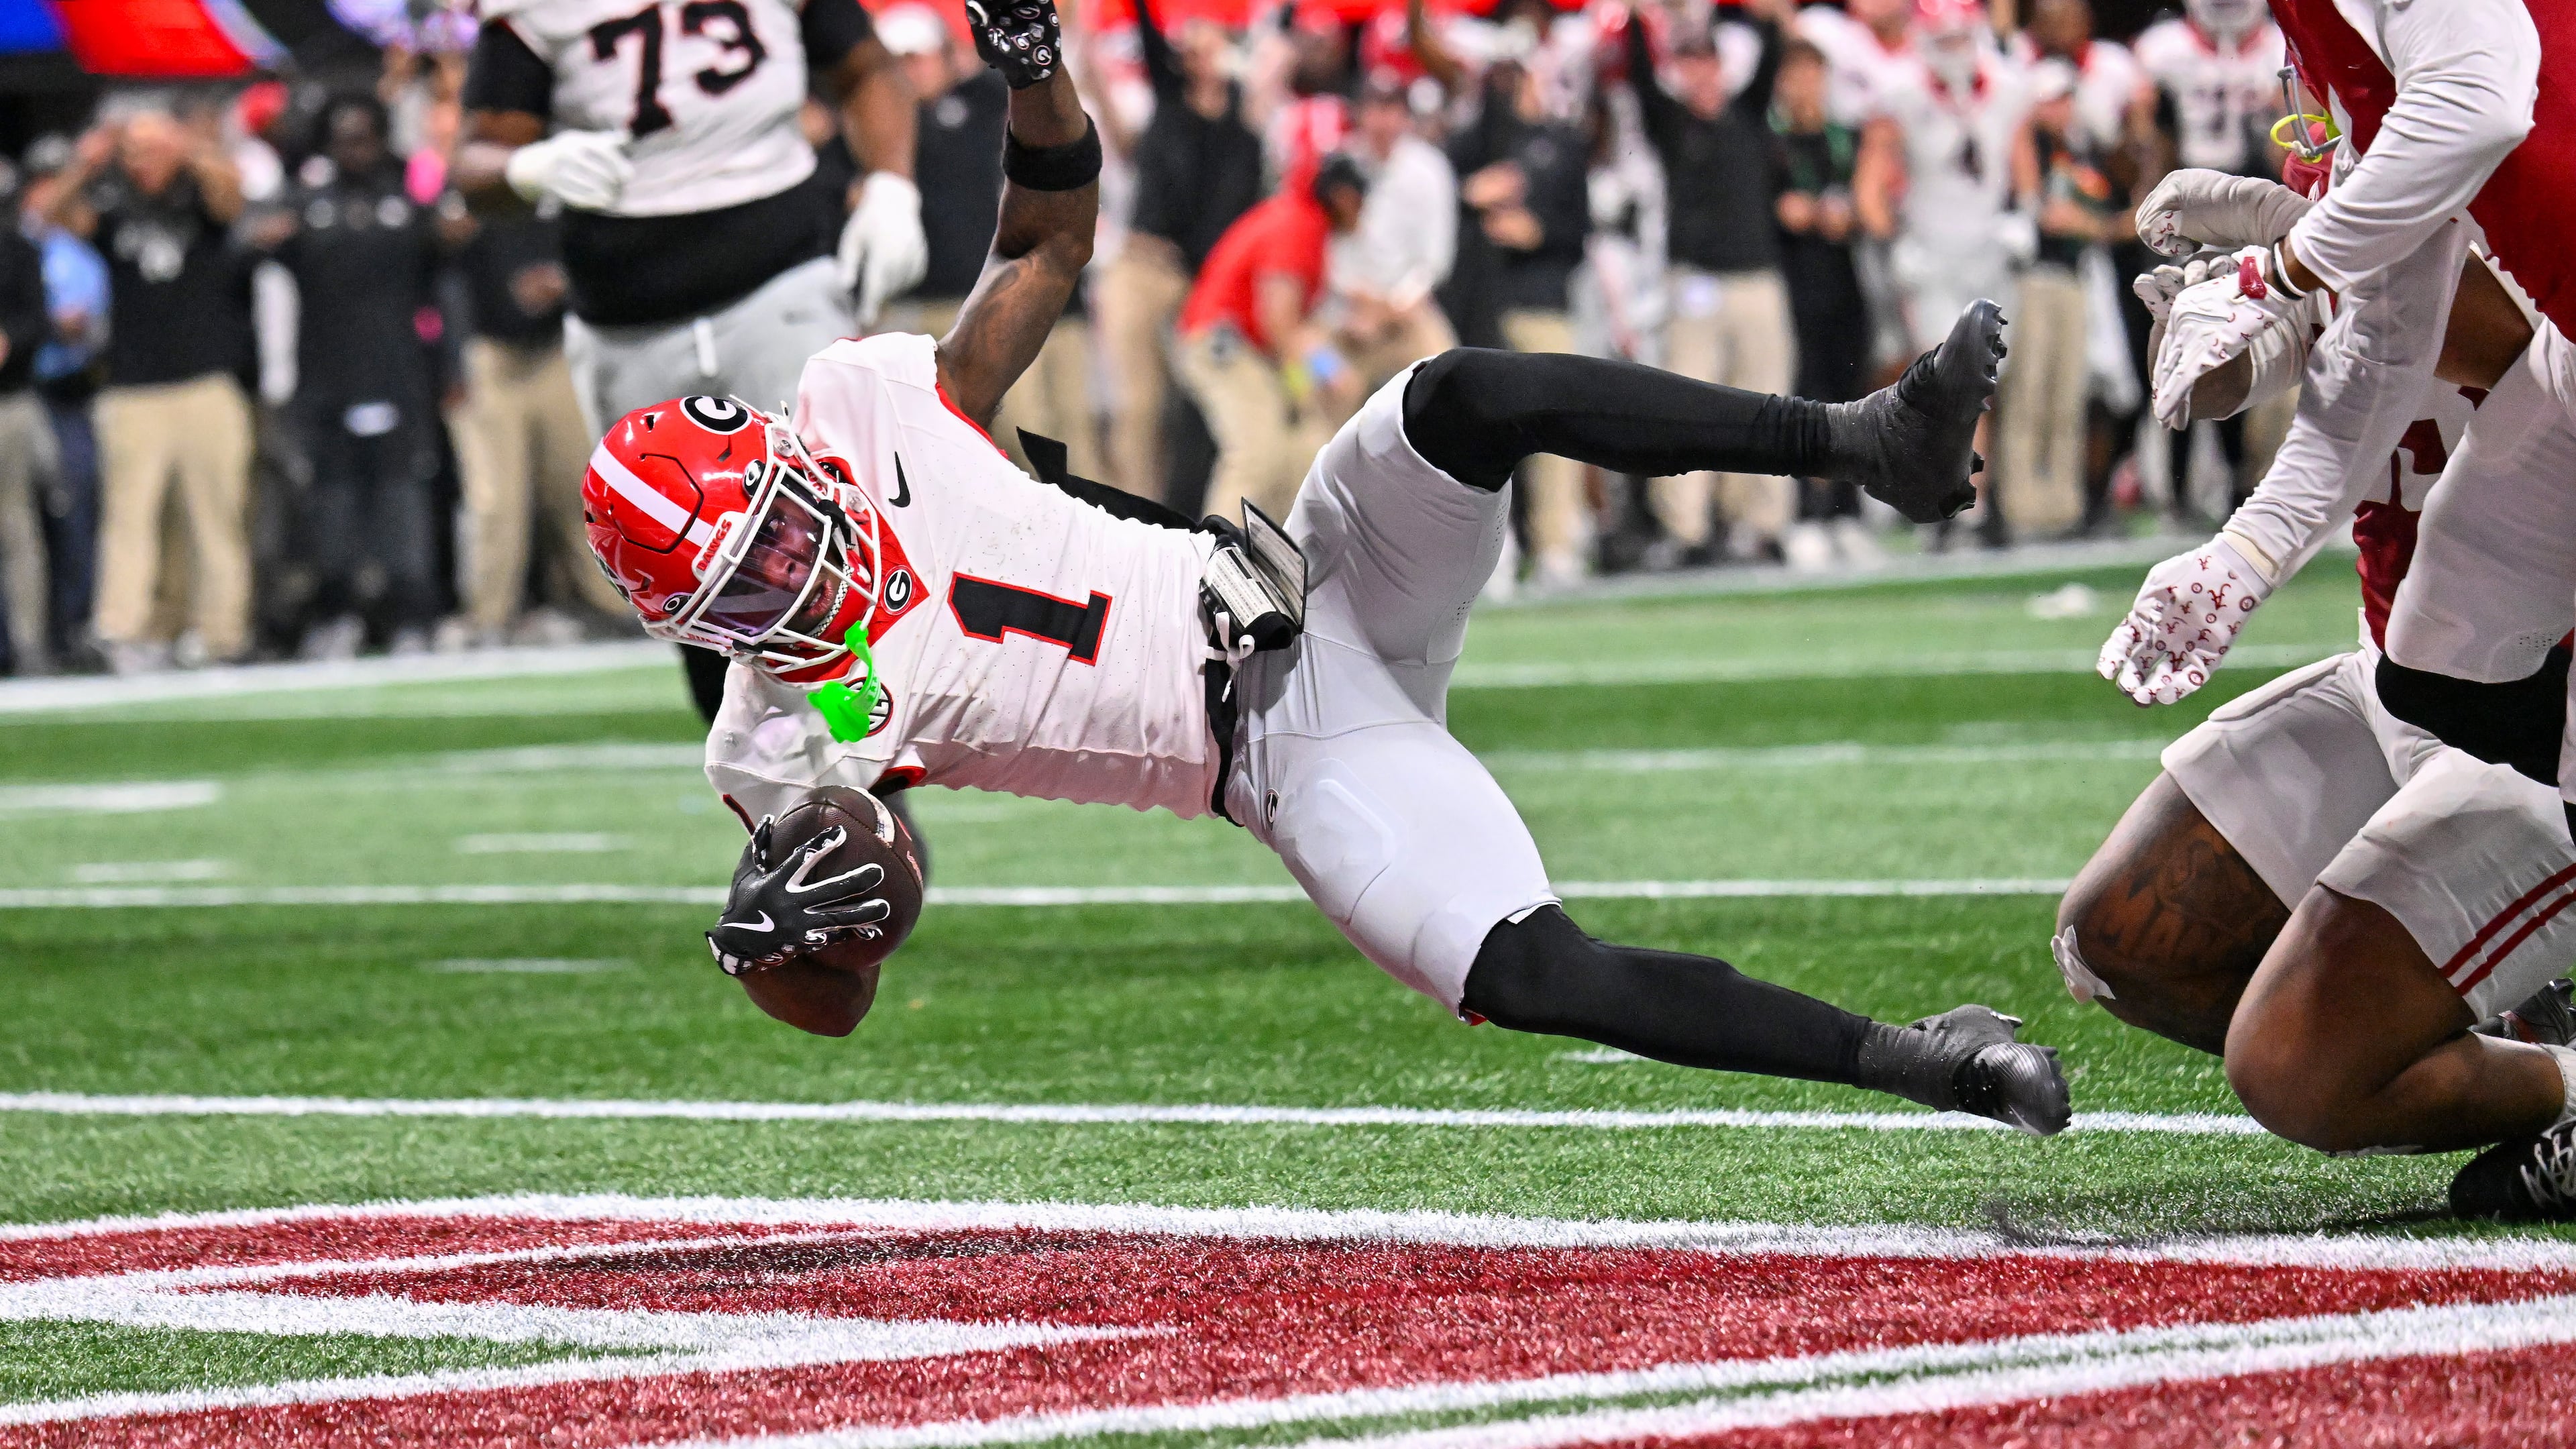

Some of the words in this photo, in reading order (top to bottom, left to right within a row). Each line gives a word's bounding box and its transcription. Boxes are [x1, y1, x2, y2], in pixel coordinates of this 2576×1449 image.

[586, 0, 767, 138] 73
[683, 396, 749, 433] G
[696, 519, 732, 572] DAWGS
[884, 570, 912, 611] G
[947, 571, 1113, 667] 1
